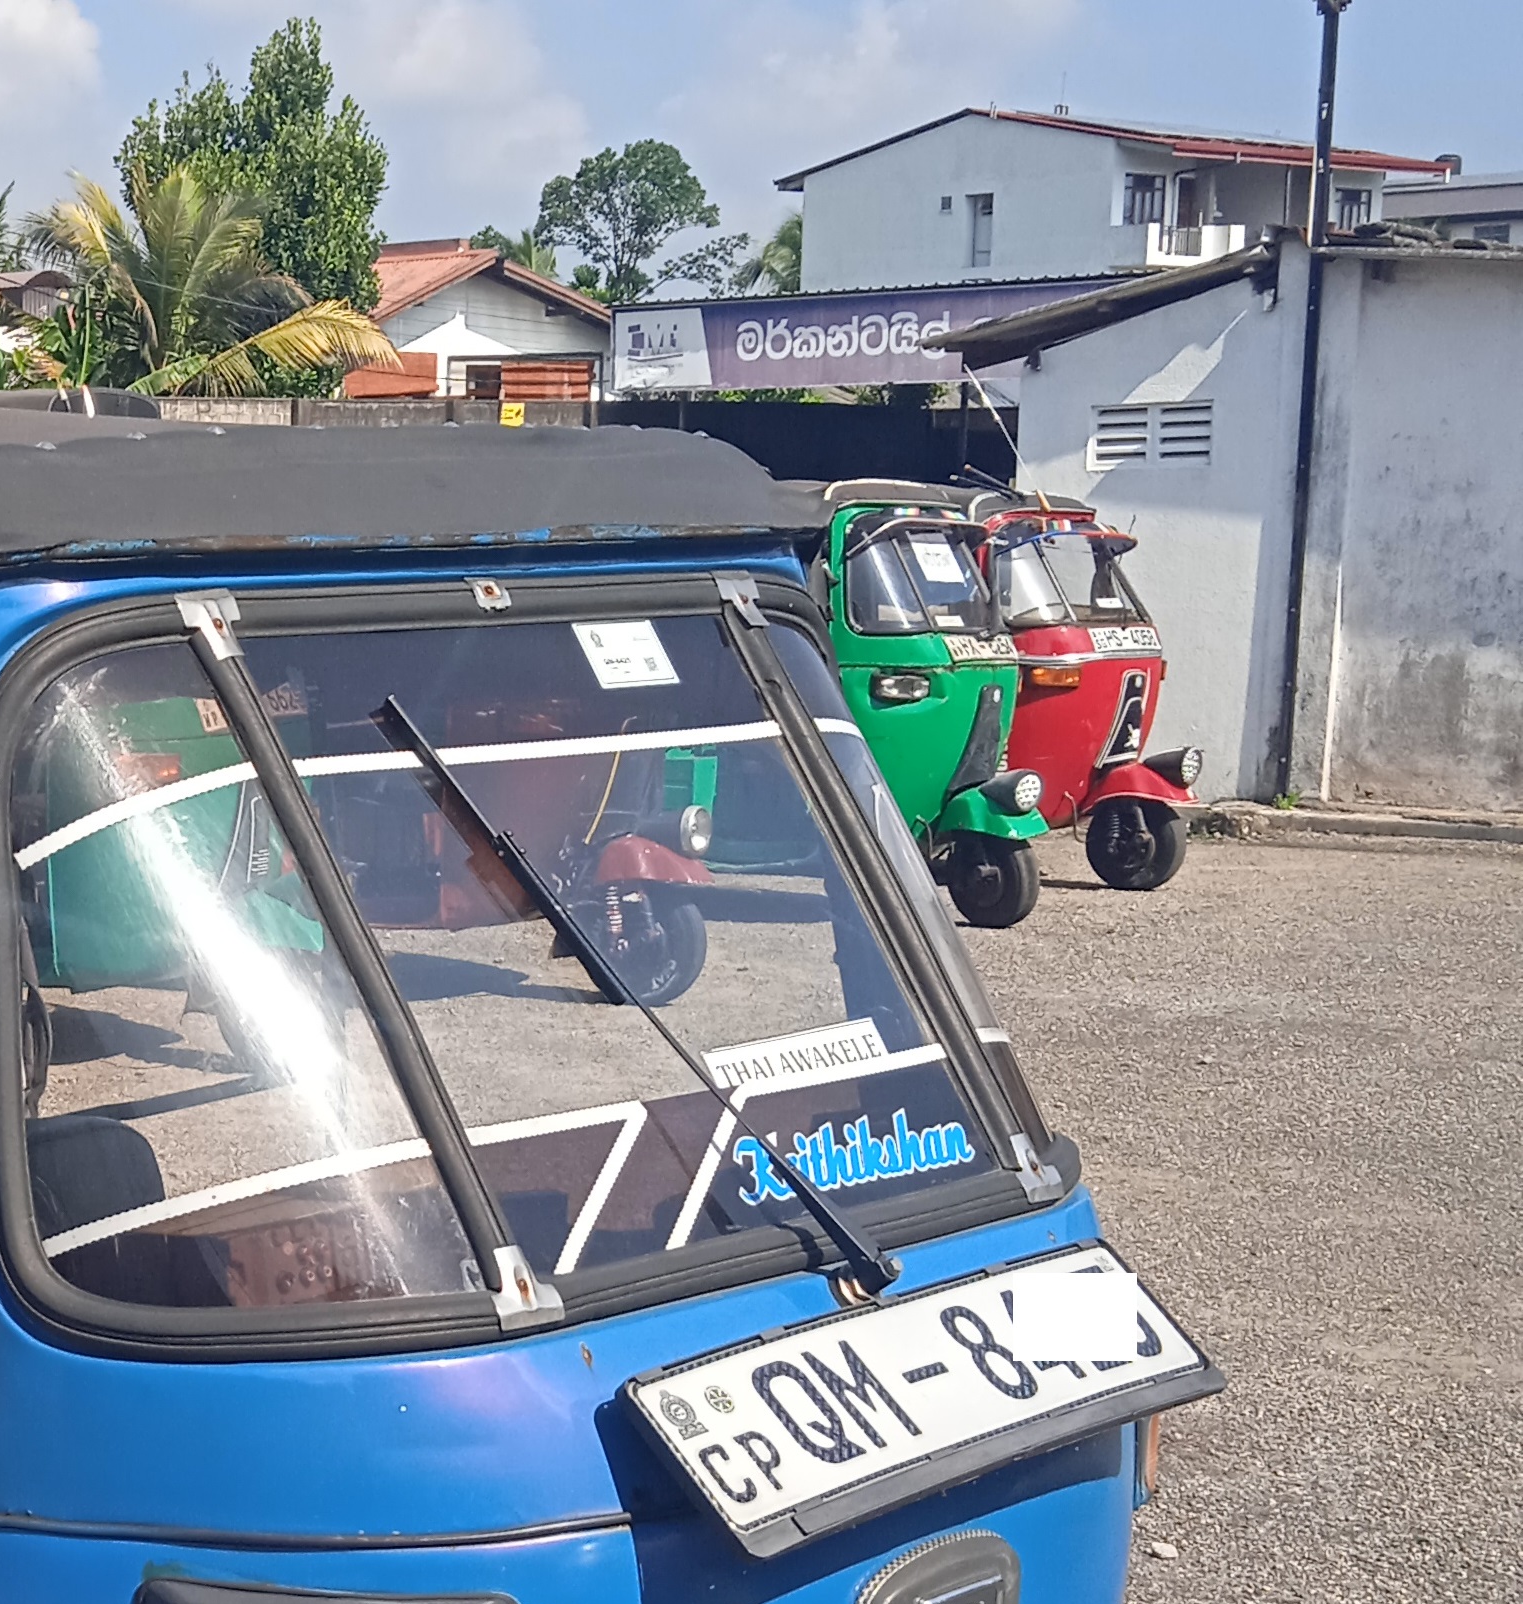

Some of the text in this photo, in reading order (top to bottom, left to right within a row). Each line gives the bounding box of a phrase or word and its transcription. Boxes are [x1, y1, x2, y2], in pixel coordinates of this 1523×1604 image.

[733, 1108, 975, 1206] Kithikshan
[699, 1265, 1163, 1504] CP QM-8
